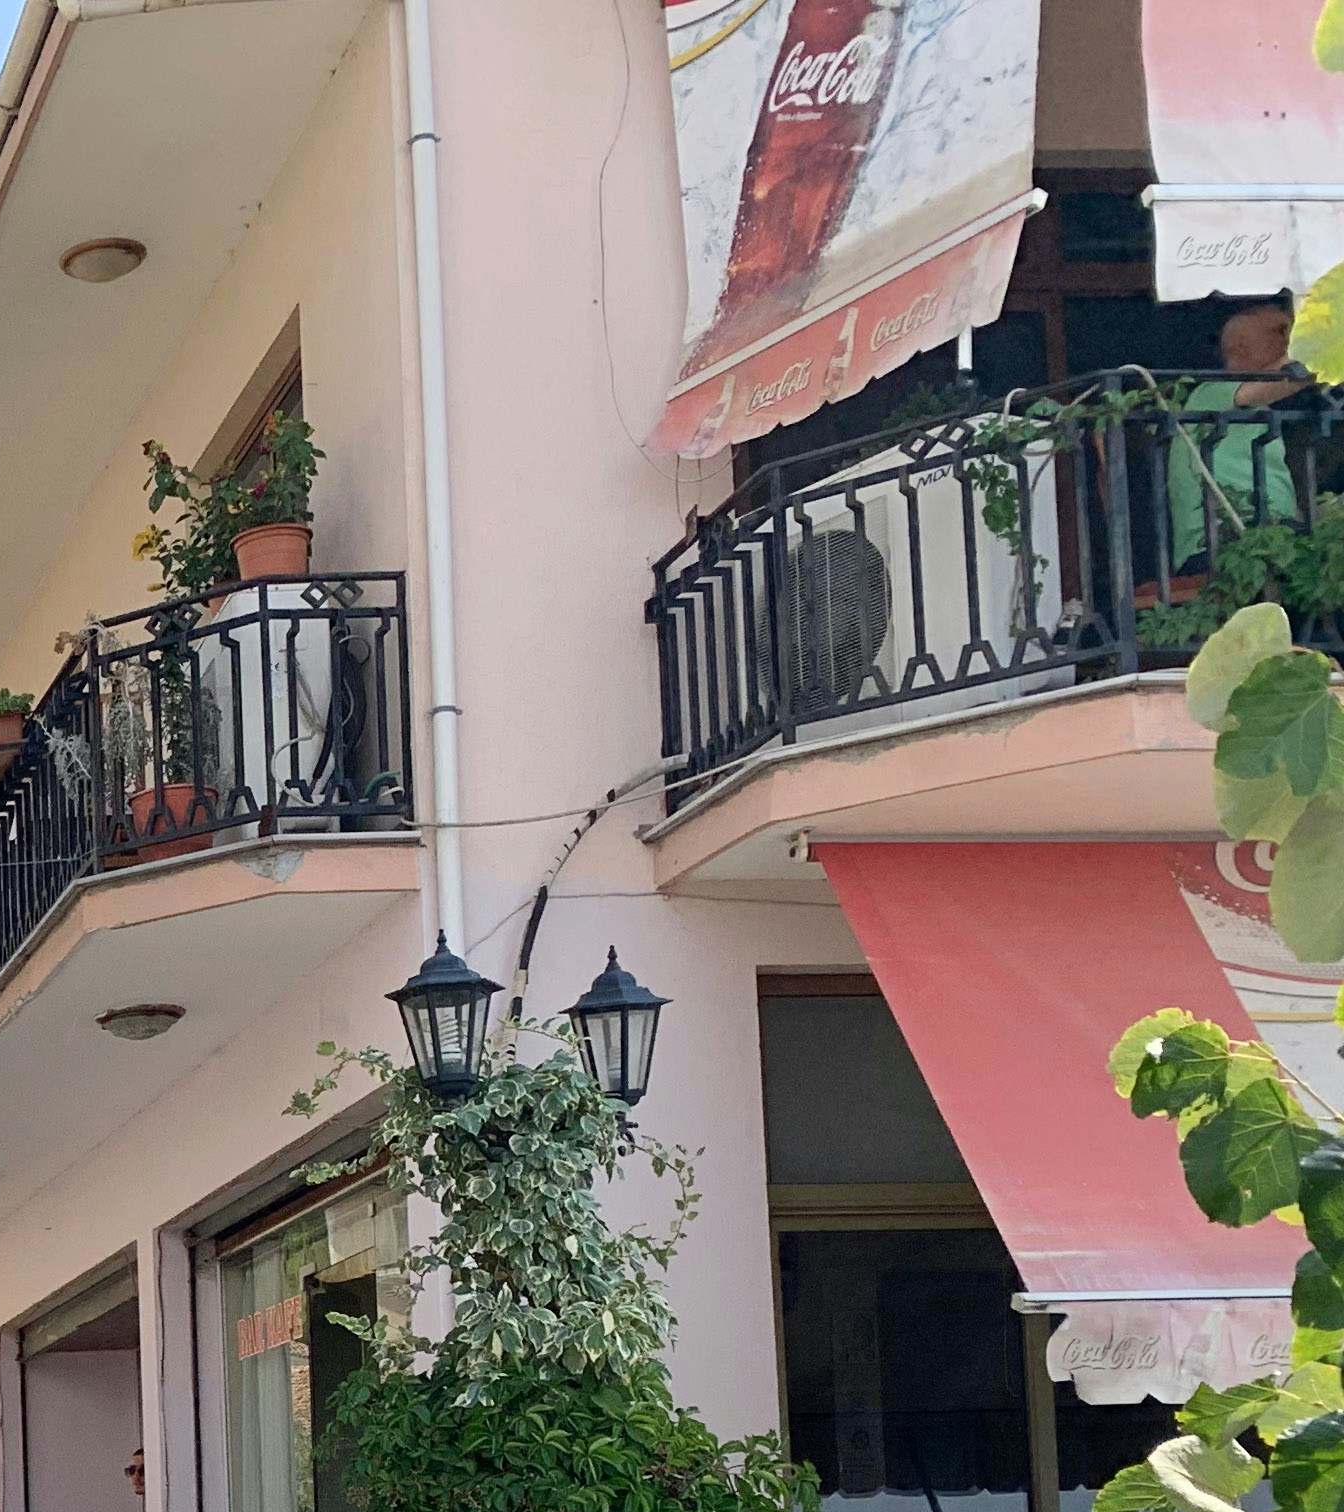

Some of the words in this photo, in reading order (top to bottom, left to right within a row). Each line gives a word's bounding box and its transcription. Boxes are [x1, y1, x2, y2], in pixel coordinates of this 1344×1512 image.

[769, 34, 892, 112] Coca-Cola
[1175, 231, 1273, 268] Coca-Cola
[870, 288, 942, 352] Coca-Cola
[745, 357, 814, 416] Coca-Cola
[1062, 1334, 1161, 1370] Coca-Cola
